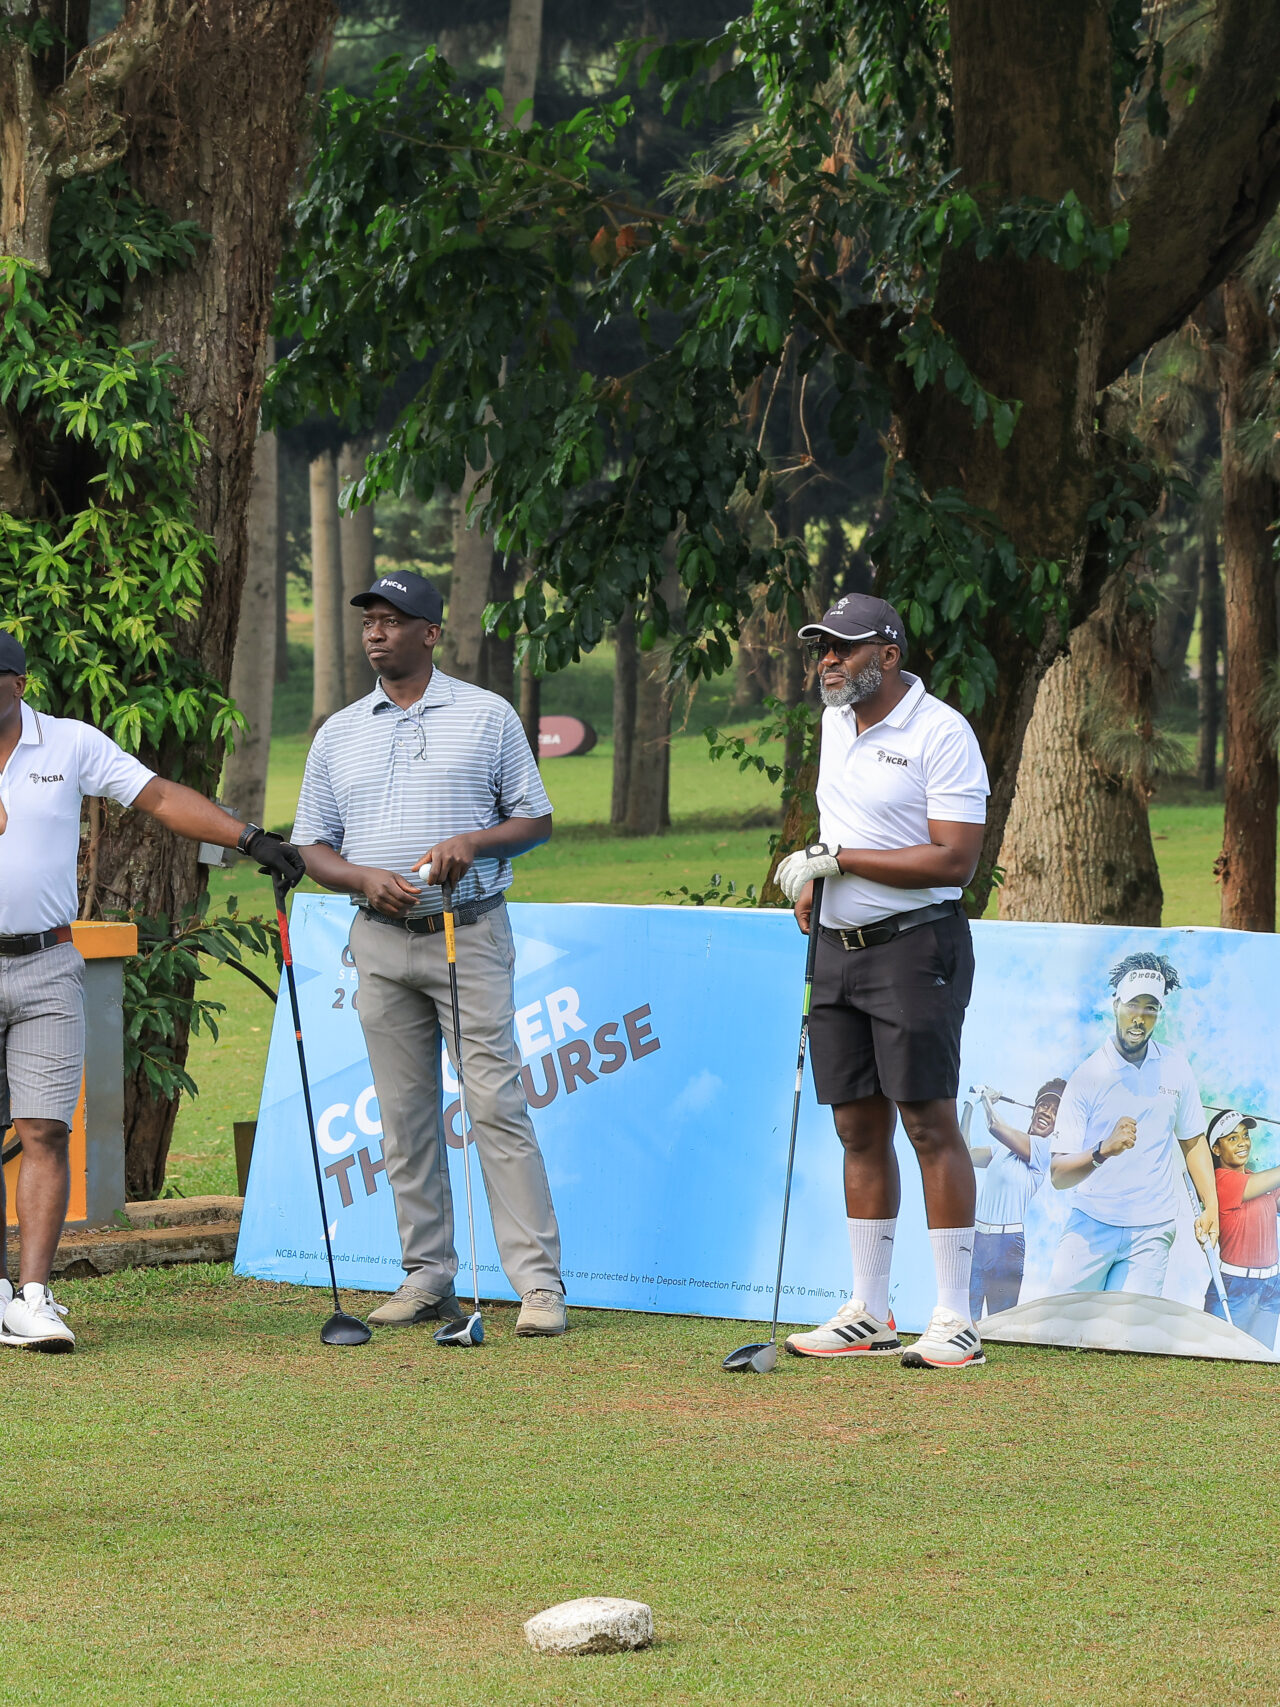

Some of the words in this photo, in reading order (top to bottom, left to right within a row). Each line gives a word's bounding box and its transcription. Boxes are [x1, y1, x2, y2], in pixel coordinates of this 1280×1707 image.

[386, 580, 407, 593] NCBA
[885, 755, 908, 768] NCBA
[41, 773, 65, 783] NCBA
[275, 1249, 297, 1259] NCBA
[299, 1250, 318, 1260] Bank
[351, 1253, 380, 1264] Limited
[576, 1270, 589, 1279] are
[590, 1271, 629, 1282] protected
[630, 1273, 640, 1284] by
[641, 1274, 655, 1284] the
[656, 1275, 687, 1286] Deposit
[688, 1277, 729, 1290] Protection
[731, 1281, 752, 1292] Fund
[753, 1284, 764, 1294] up
[765, 1284, 774, 1293] to
[797, 1286, 806, 1296] 10
[807, 1287, 836, 1299] million.
